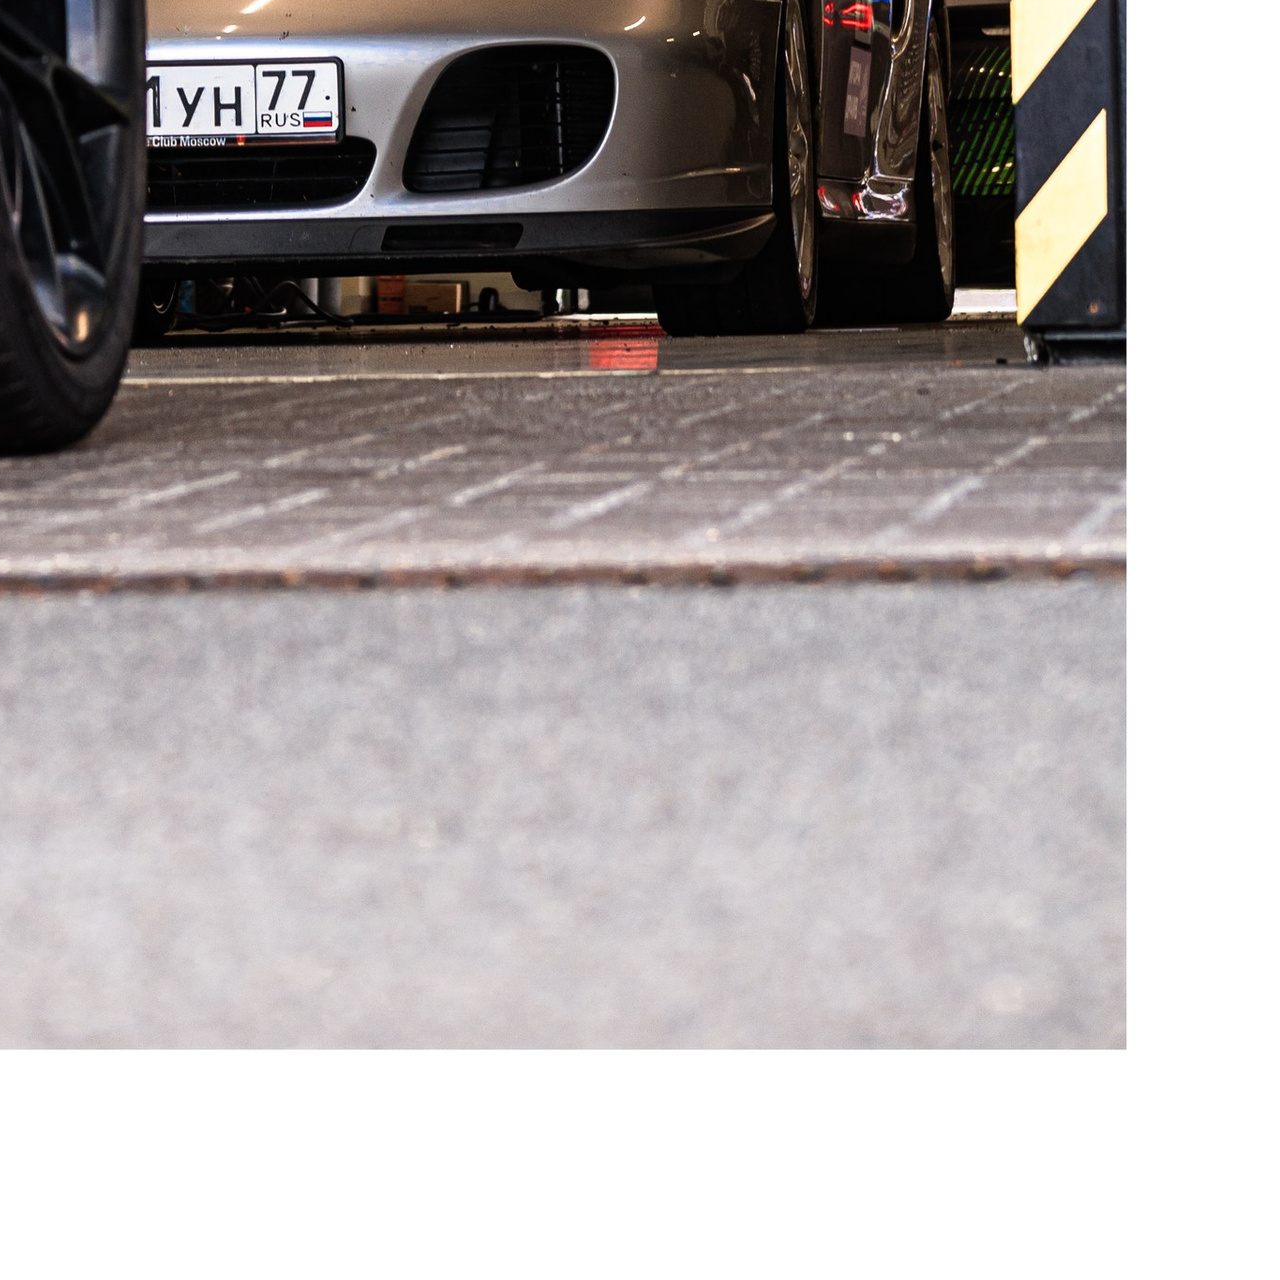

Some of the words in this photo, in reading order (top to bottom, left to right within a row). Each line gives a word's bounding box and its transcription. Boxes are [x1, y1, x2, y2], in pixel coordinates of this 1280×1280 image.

[262, 69, 316, 111] 77
[261, 112, 301, 128] RUS
[152, 136, 177, 147] Club
[179, 136, 226, 147] Moscow
